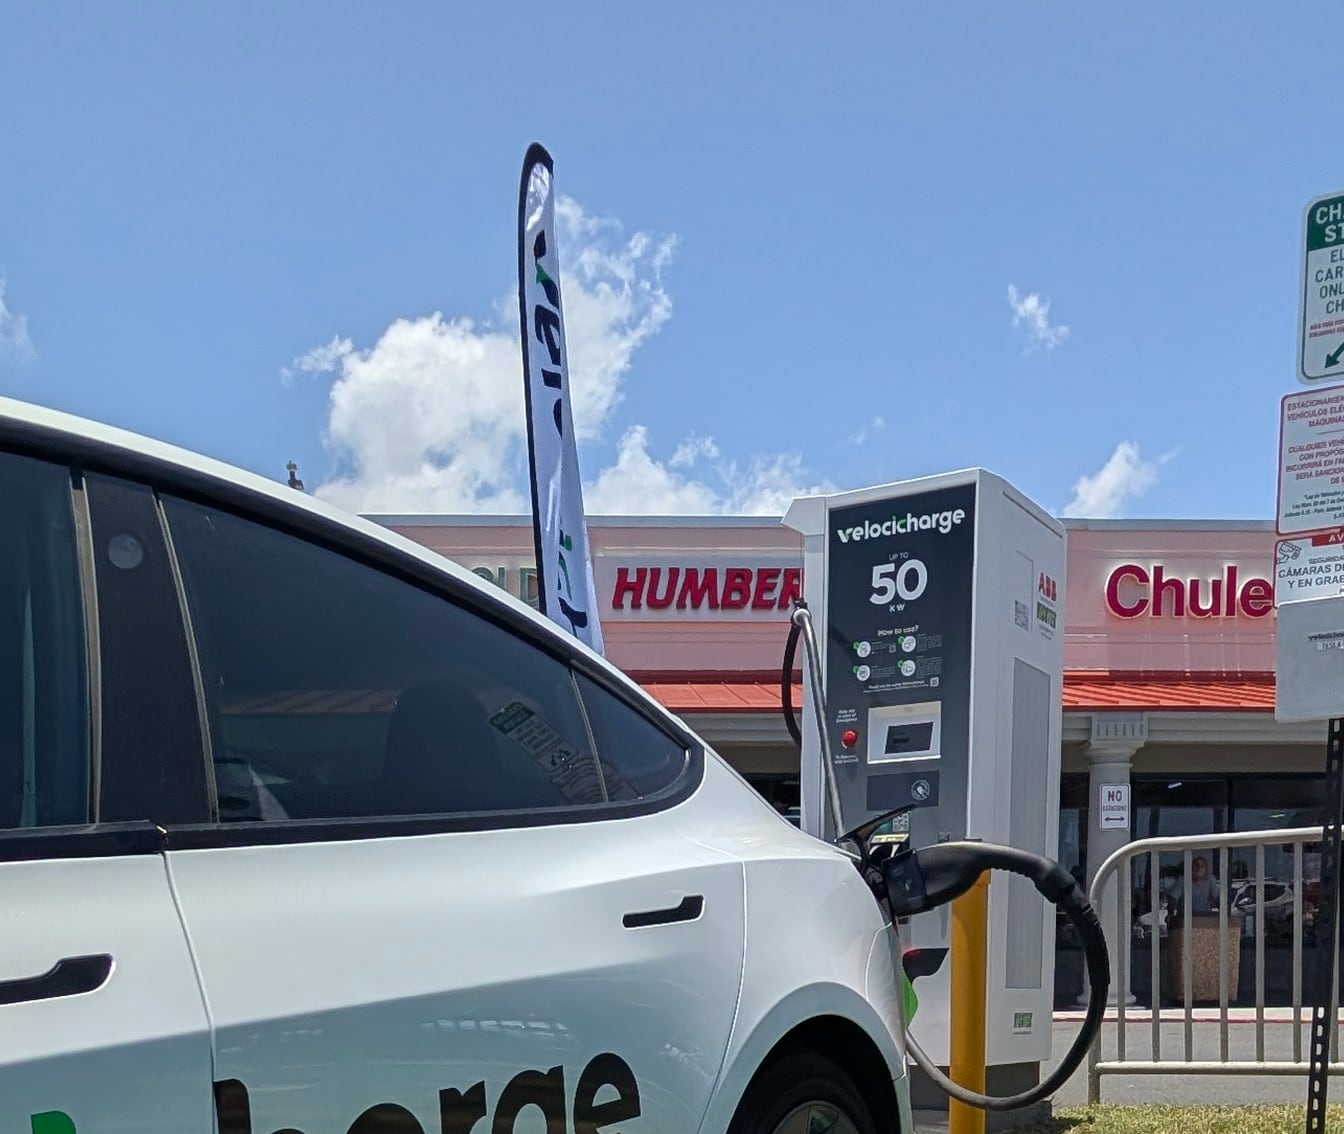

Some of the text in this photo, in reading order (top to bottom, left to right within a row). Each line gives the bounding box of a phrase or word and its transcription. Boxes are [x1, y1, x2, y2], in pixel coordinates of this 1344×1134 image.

[1315, 265, 1343, 284] CAR
[837, 508, 965, 544] velocicharge
[1278, 564, 1331, 578] CÁMARAS
[869, 558, 928, 605] 50
[1106, 564, 1275, 617] Chule
[1288, 580, 1295, 589] Y
[1298, 579, 1312, 588] EN
[1107, 790, 1123, 801] NO
